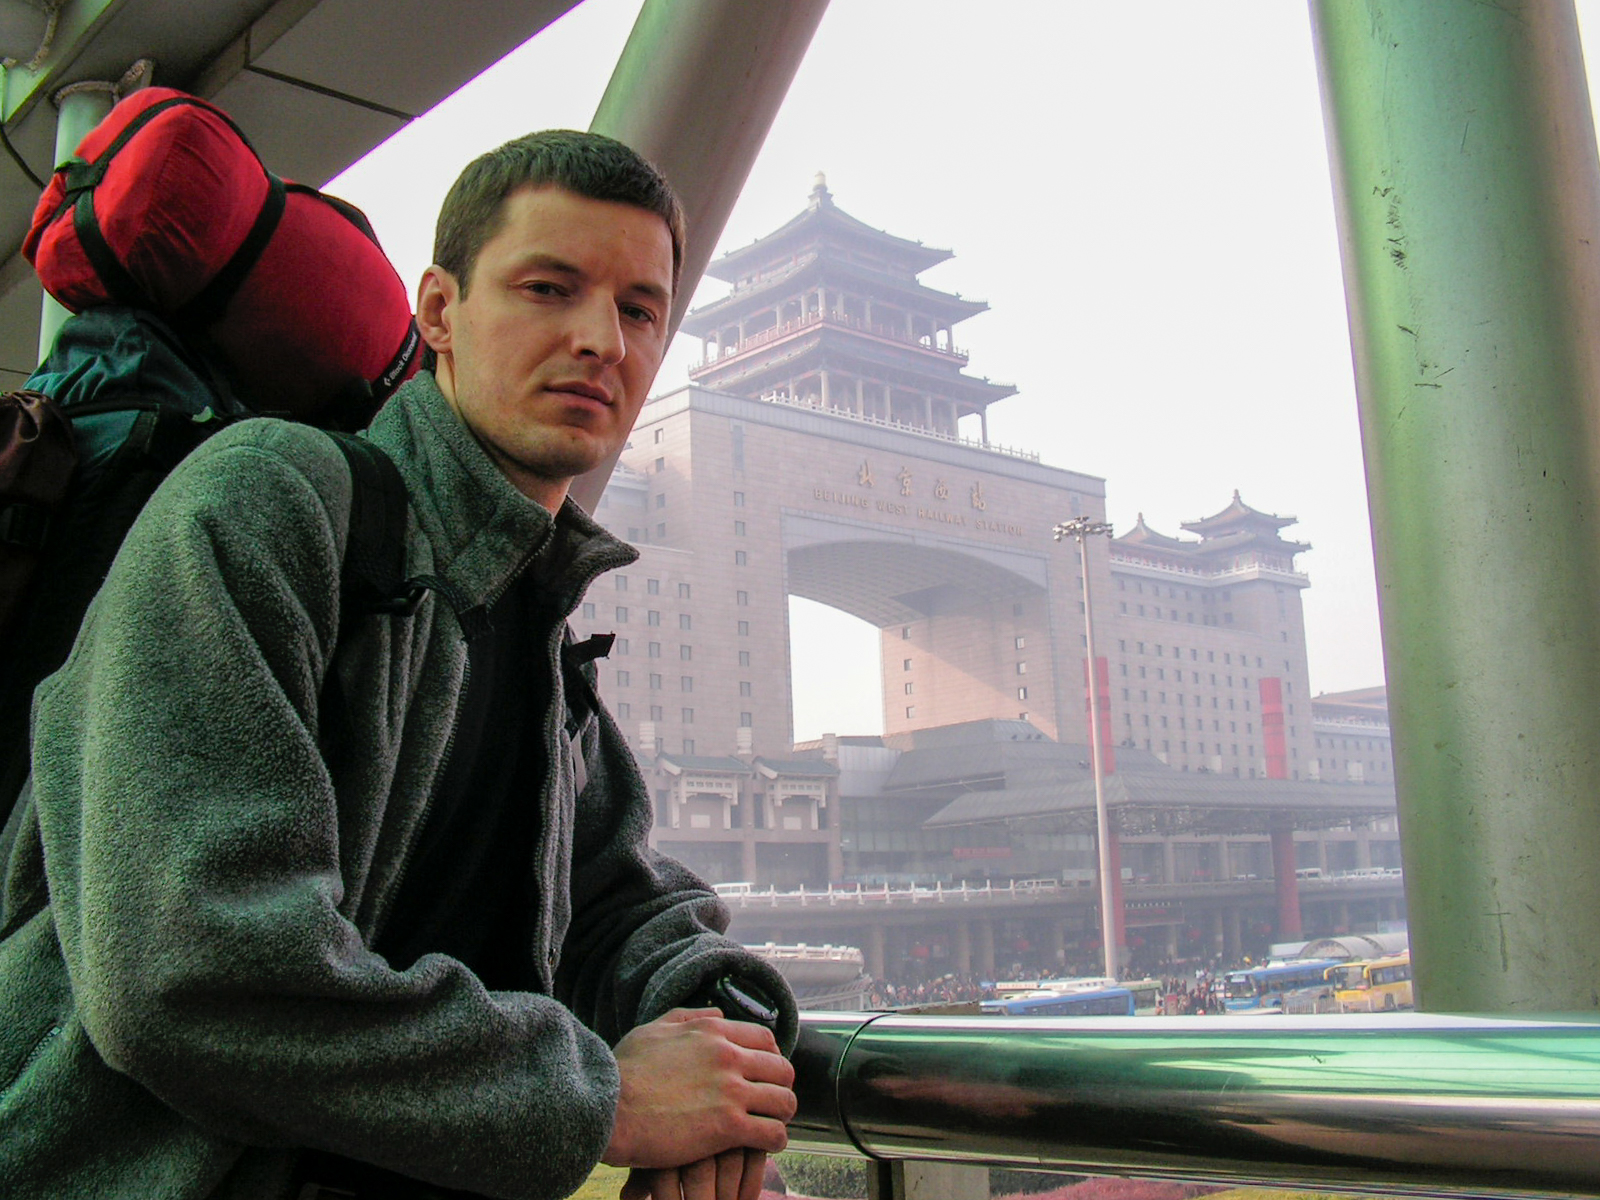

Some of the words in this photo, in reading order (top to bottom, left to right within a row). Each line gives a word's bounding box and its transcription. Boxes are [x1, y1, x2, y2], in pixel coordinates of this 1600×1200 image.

[389, 360, 406, 380] Black
[858, 459, 987, 511] 北京西站
[813, 488, 869, 508] BEIJING
[876, 500, 909, 515] WEST
[917, 508, 968, 528] RAILWAY
[975, 519, 1023, 537] STATION
